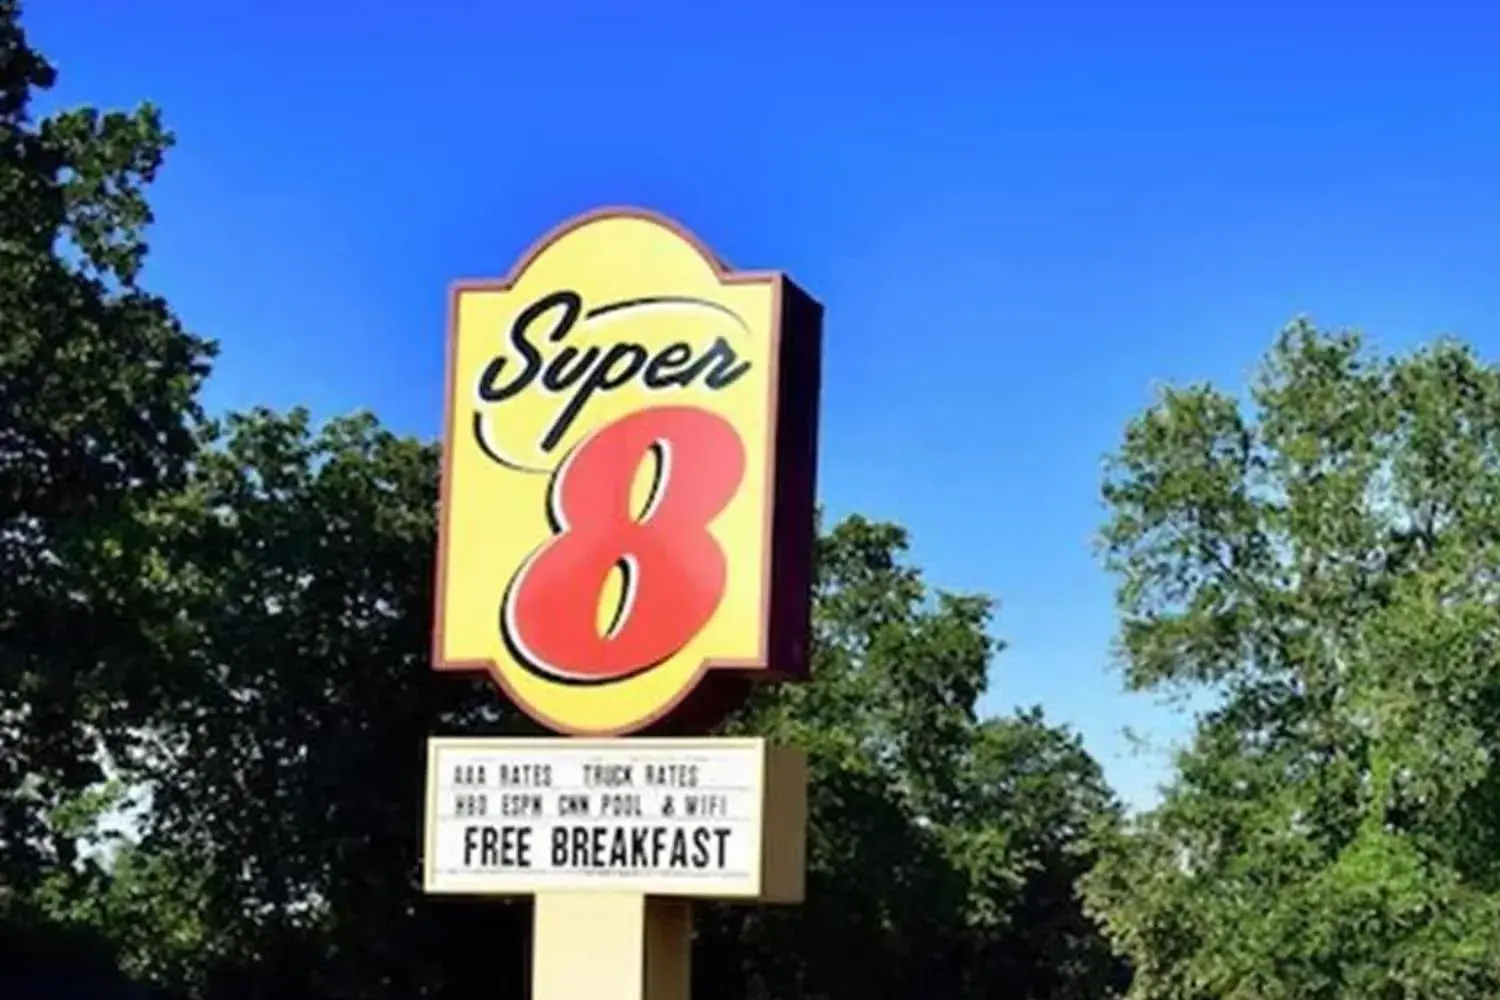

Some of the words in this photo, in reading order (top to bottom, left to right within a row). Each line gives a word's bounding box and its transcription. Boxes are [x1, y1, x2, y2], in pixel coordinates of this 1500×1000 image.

[479, 291, 752, 453] Super
[500, 405, 748, 686] 8
[454, 764, 486, 785] AAA
[499, 764, 552, 788] RATES
[582, 764, 633, 788] TRUCK
[645, 764, 699, 788] RATES
[454, 794, 487, 816] HBO
[501, 794, 543, 817] ESPN
[558, 794, 591, 817] CNN
[601, 794, 642, 817] POOL
[661, 795, 675, 817] &
[684, 794, 728, 817] WIFI
[463, 826, 532, 867] FREE
[551, 826, 732, 869] BREAKFAST
